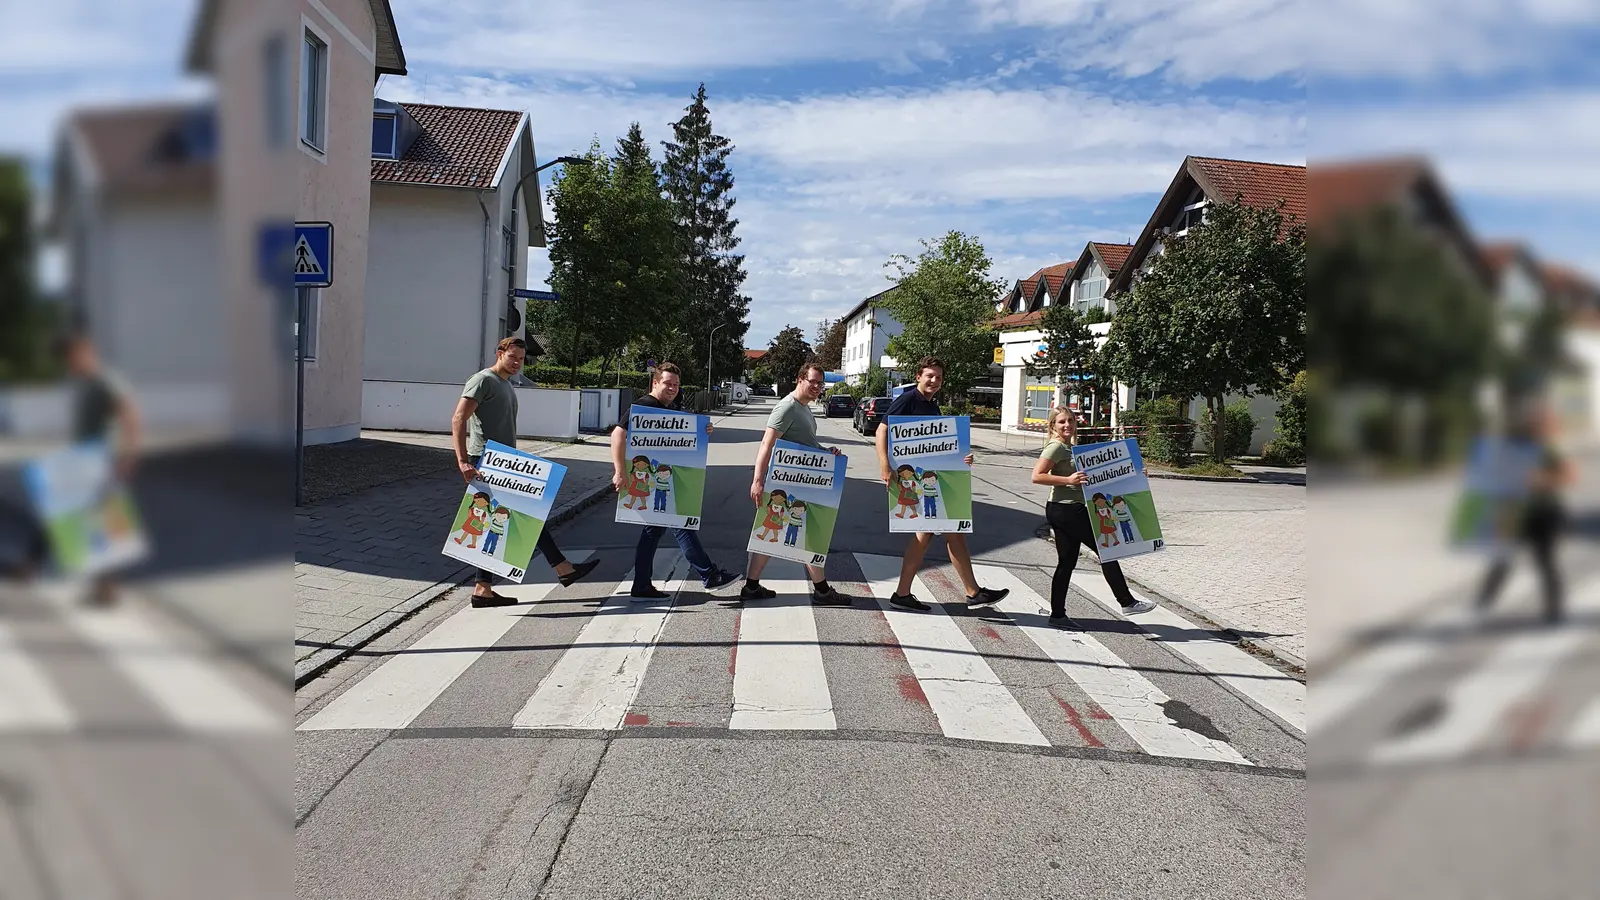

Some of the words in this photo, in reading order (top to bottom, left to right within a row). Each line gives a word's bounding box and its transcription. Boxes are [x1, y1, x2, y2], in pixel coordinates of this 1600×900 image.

[631, 415, 689, 430] Vorsicht:
[890, 421, 948, 439] Vorsicht:
[630, 435, 697, 448] Schulkinder!
[892, 439, 958, 457] Schulkinder!
[484, 451, 542, 476] Vorsicht:
[775, 449, 828, 468] Vorsicht:
[1077, 447, 1122, 469] Vorsicht:
[771, 469, 834, 487] Schulkinder!
